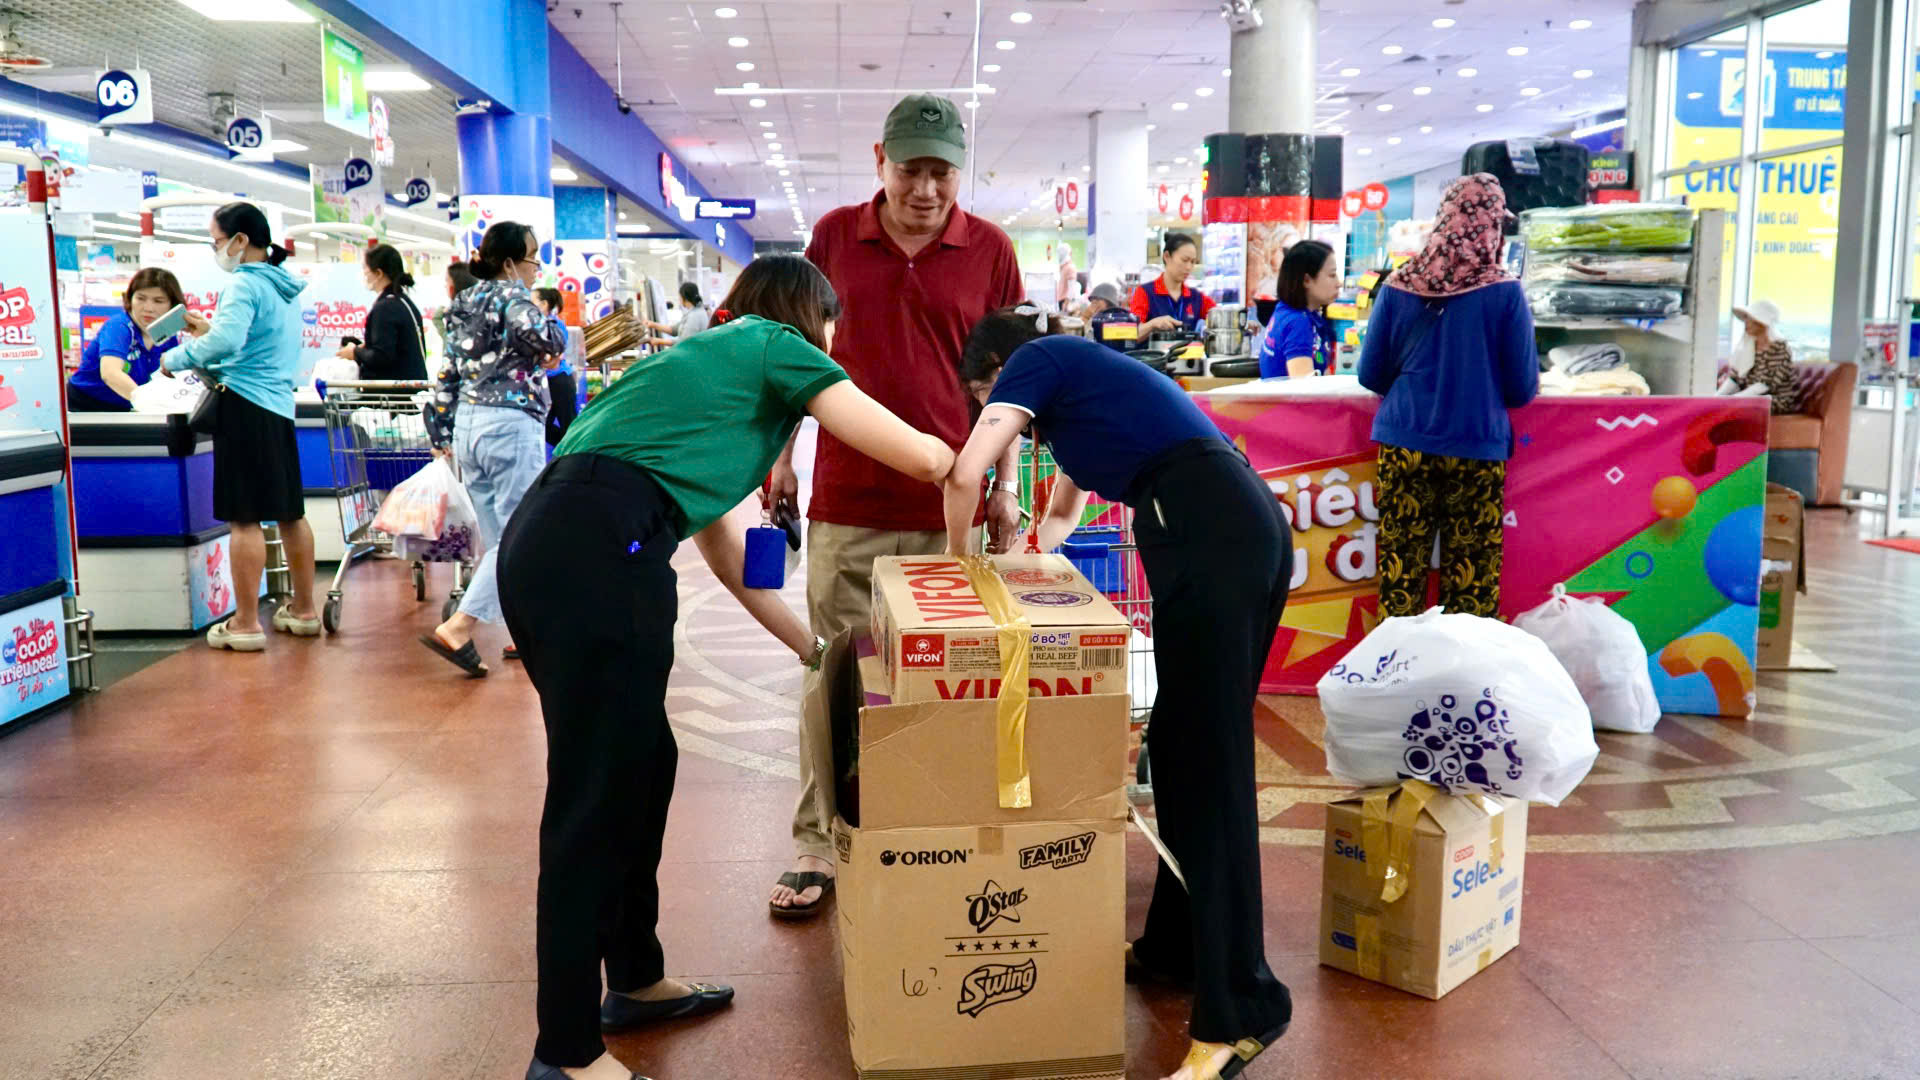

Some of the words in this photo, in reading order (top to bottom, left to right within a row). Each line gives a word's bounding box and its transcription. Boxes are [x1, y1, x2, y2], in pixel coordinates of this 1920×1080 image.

[1787, 67, 1830, 89] TRUNG
[98, 79, 136, 107] 06
[229, 126, 260, 147] 05
[142, 174, 157, 186] 02
[346, 165, 370, 182] 04
[1760, 154, 1837, 194] THUÊ
[406, 184, 428, 199] 03
[320, 310, 367, 327] CO.OP
[900, 561, 990, 623] VIFON
[18, 628, 55, 660] CO.OP
[1041, 633, 1057, 644] BÒ
[906, 653, 941, 663] VIFON
[1036, 652, 1057, 661] REAL
[1058, 651, 1079, 660] BEEF
[900, 849, 967, 866] ORION
[1021, 833, 1095, 867] FAMILY
[1054, 852, 1086, 867] PARTY
[967, 886, 1026, 928] O'Star
[958, 964, 1036, 1015] Swing
